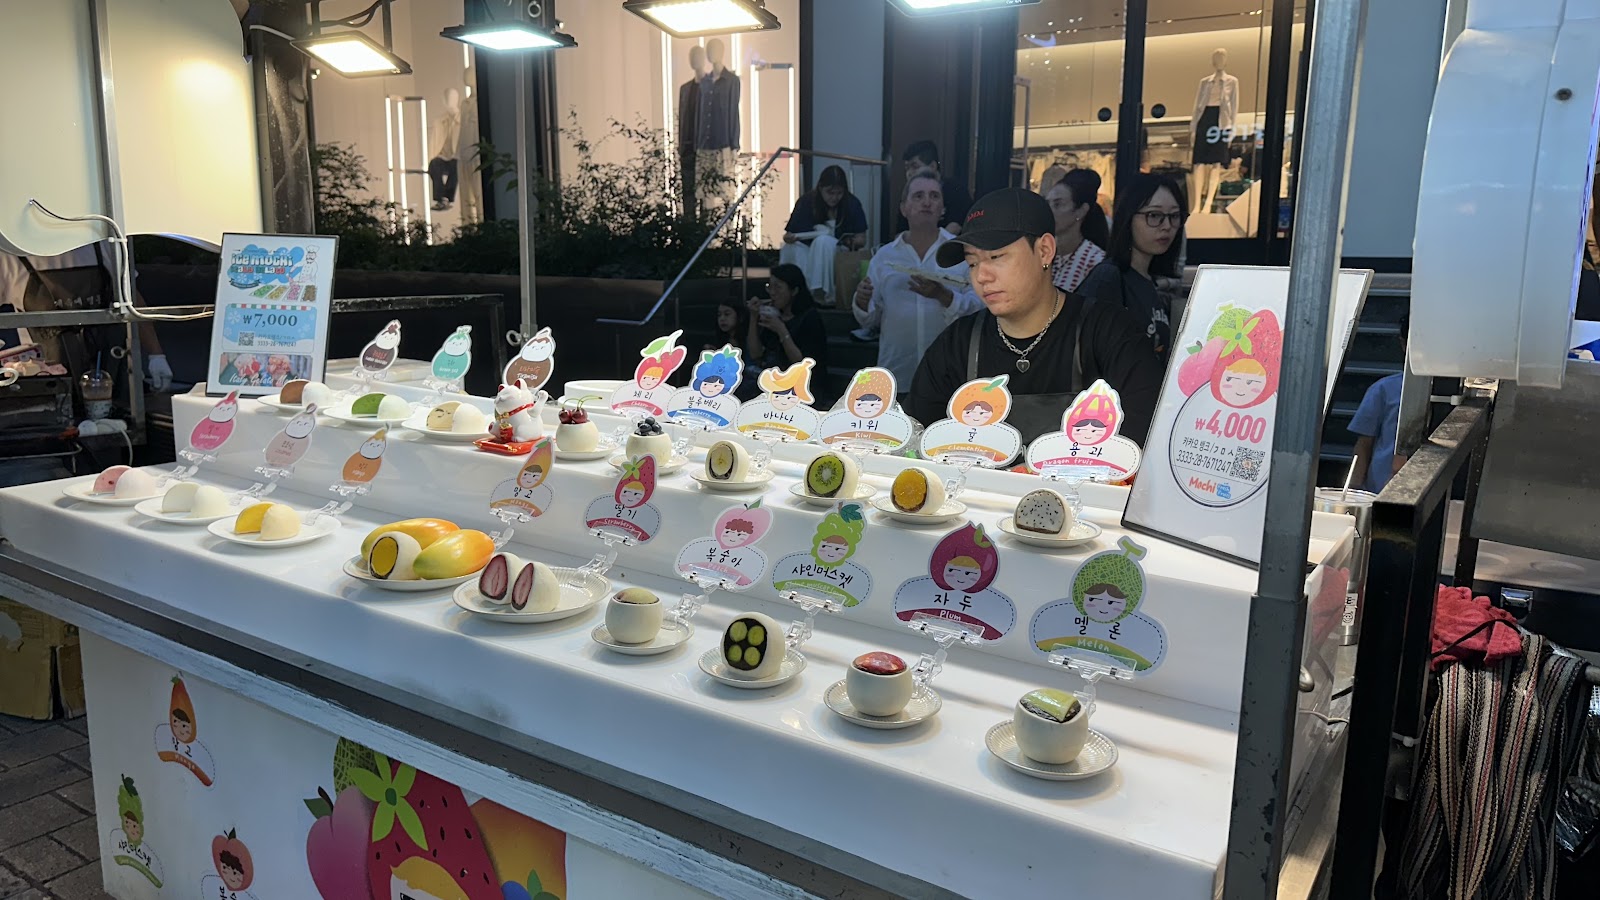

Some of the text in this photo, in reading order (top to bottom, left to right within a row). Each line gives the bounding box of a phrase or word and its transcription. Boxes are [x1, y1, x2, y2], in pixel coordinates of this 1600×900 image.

[243, 313, 298, 328] ₩7,000
[687, 396, 721, 410] 블루베리
[763, 411, 794, 423] 바나나
[1195, 409, 1266, 443] ₩4,000
[968, 428, 977, 442] 귤
[1176, 449, 1231, 473] 3333-28-7671247
[1189, 476, 1217, 493] Mochi
[604, 519, 636, 531] Strawberry
[791, 563, 853, 588] 샤인머스켓
[940, 610, 961, 621] Plum
[1077, 638, 1110, 652] Melon
